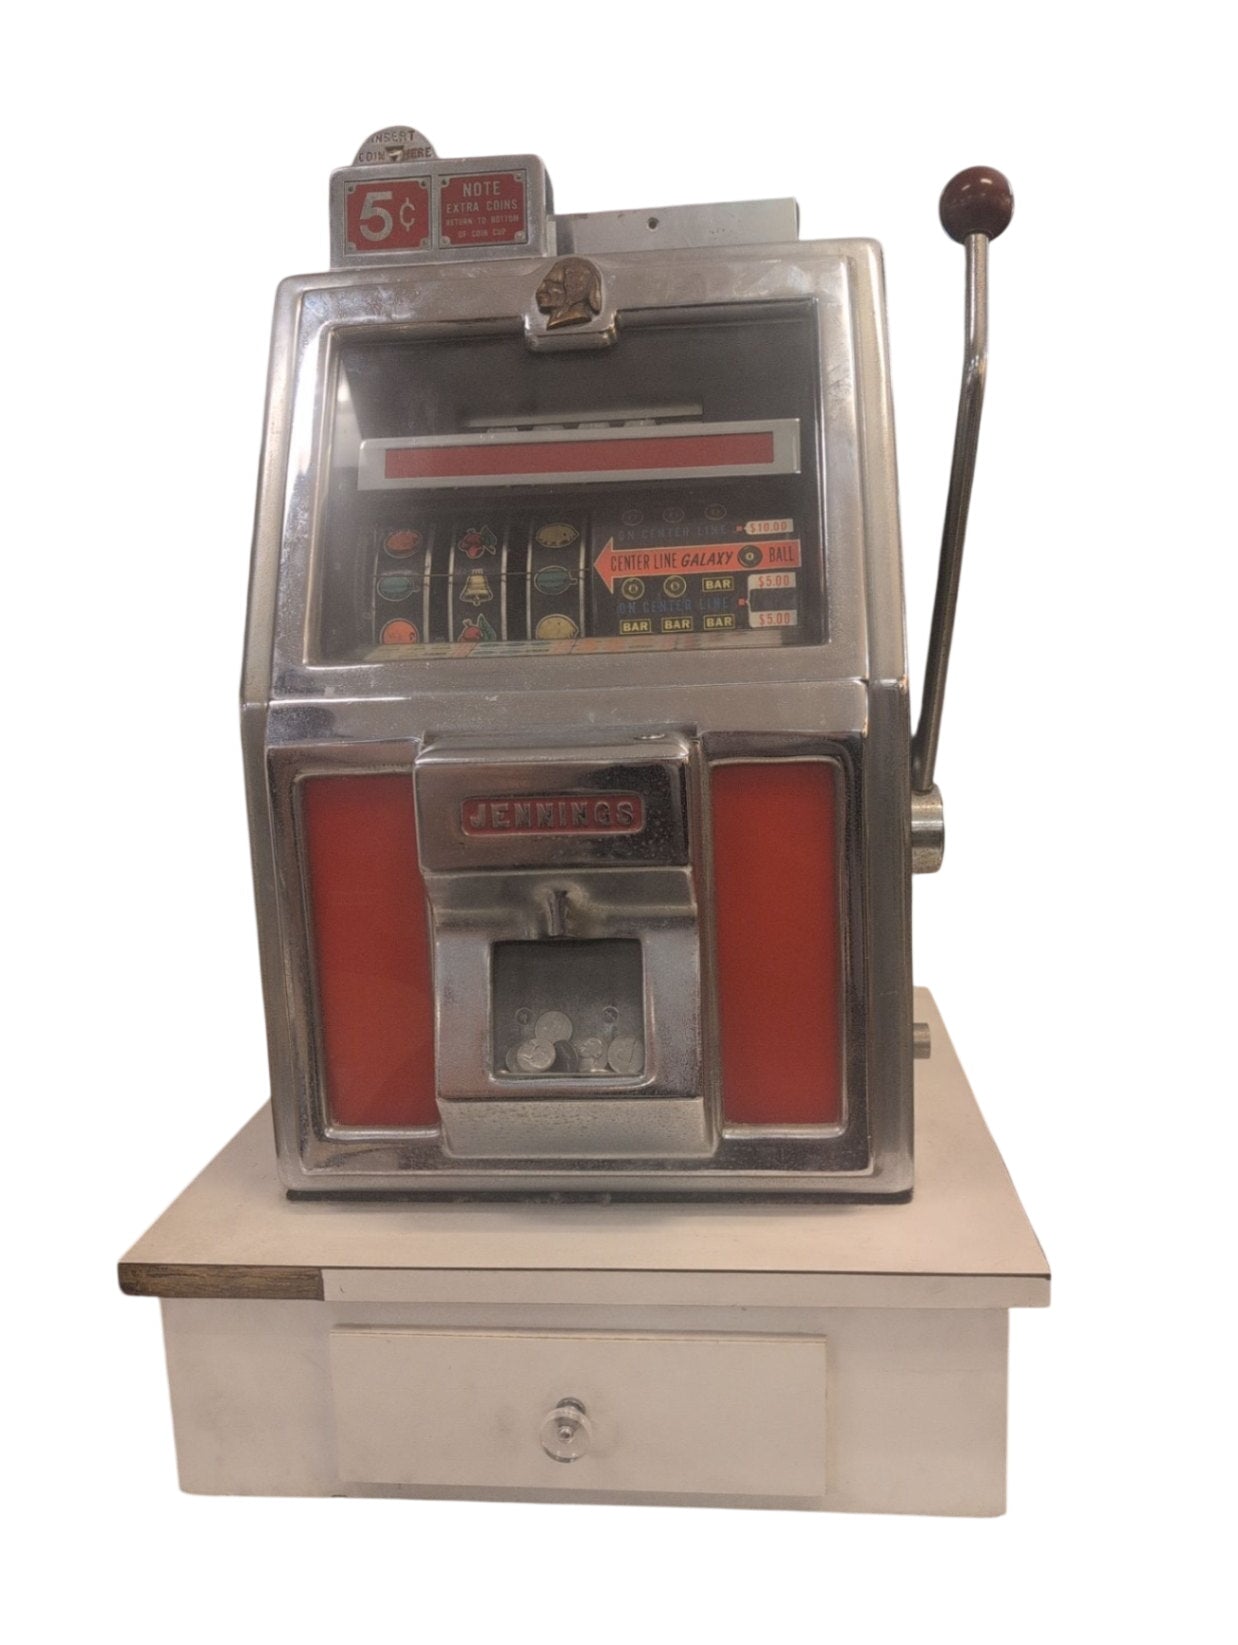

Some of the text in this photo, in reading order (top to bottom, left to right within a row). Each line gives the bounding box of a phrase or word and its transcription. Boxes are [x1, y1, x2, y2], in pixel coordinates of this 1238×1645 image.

[371, 130, 415, 144] INSERT
[358, 151, 385, 162] COIN
[463, 181, 501, 198] NOTE
[446, 199, 518, 215] EXTRA COINS
[360, 191, 416, 241] 5¢
[477, 217, 487, 225] TO
[750, 521, 787, 533] $10.00
[610, 554, 650, 572] CENTER
[654, 552, 677, 569] LINE
[681, 551, 733, 567] GALAXY
[769, 546, 794, 562] BALL
[705, 579, 731, 589] BAR
[758, 575, 789, 588] $5.00
[618, 597, 728, 614] ON CENTER LINE
[623, 616, 732, 631] BAR BAR BAR
[759, 612, 790, 626] $5.00
[470, 801, 633, 828] JENNINGS
